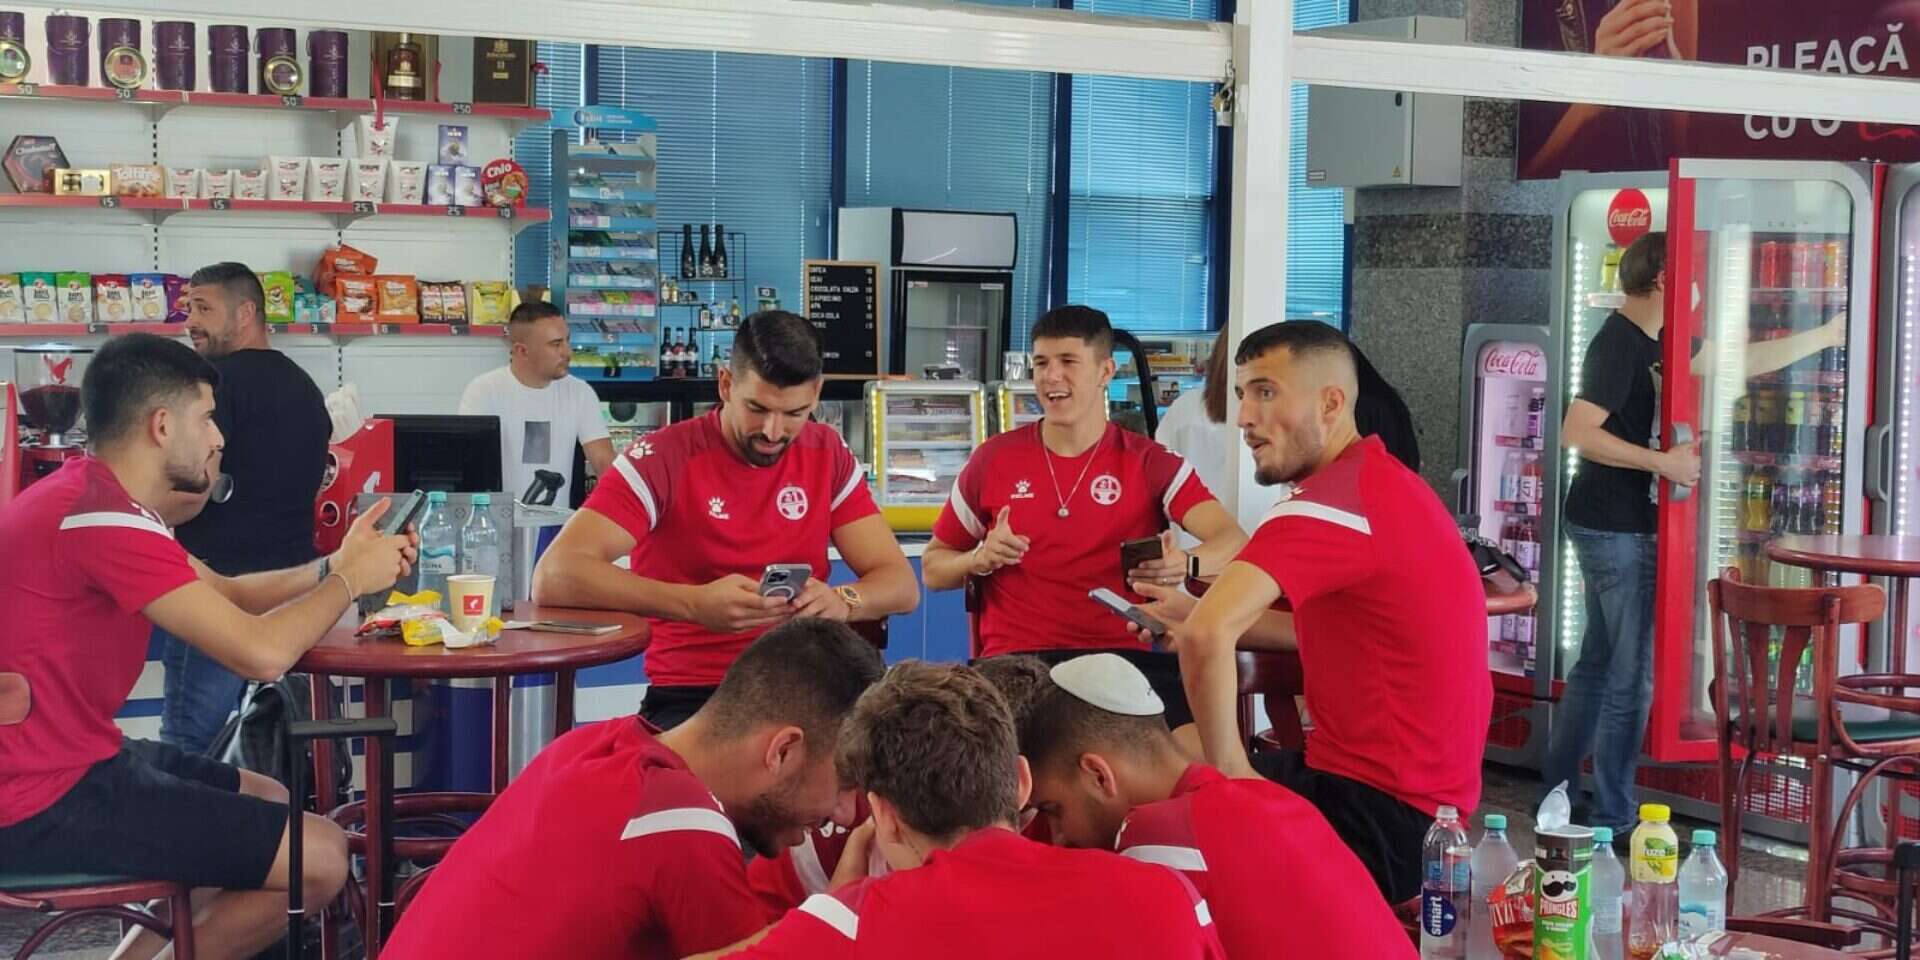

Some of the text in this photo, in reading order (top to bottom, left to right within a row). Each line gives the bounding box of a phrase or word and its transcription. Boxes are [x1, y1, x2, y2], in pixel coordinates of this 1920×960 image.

[17, 86, 33, 95] 50
[116, 89, 131, 98] 50
[282, 97, 297, 106] 50
[454, 104, 472, 114] 250
[487, 163, 512, 179] Chio
[103, 198, 115, 207] 15
[213, 200, 225, 209] 15
[354, 202, 368, 212] 25
[448, 206, 460, 216] 25
[607, 333, 614, 343] 5
[1540, 898, 1577, 918] PRINGLES
[1431, 896, 1443, 936] smart
